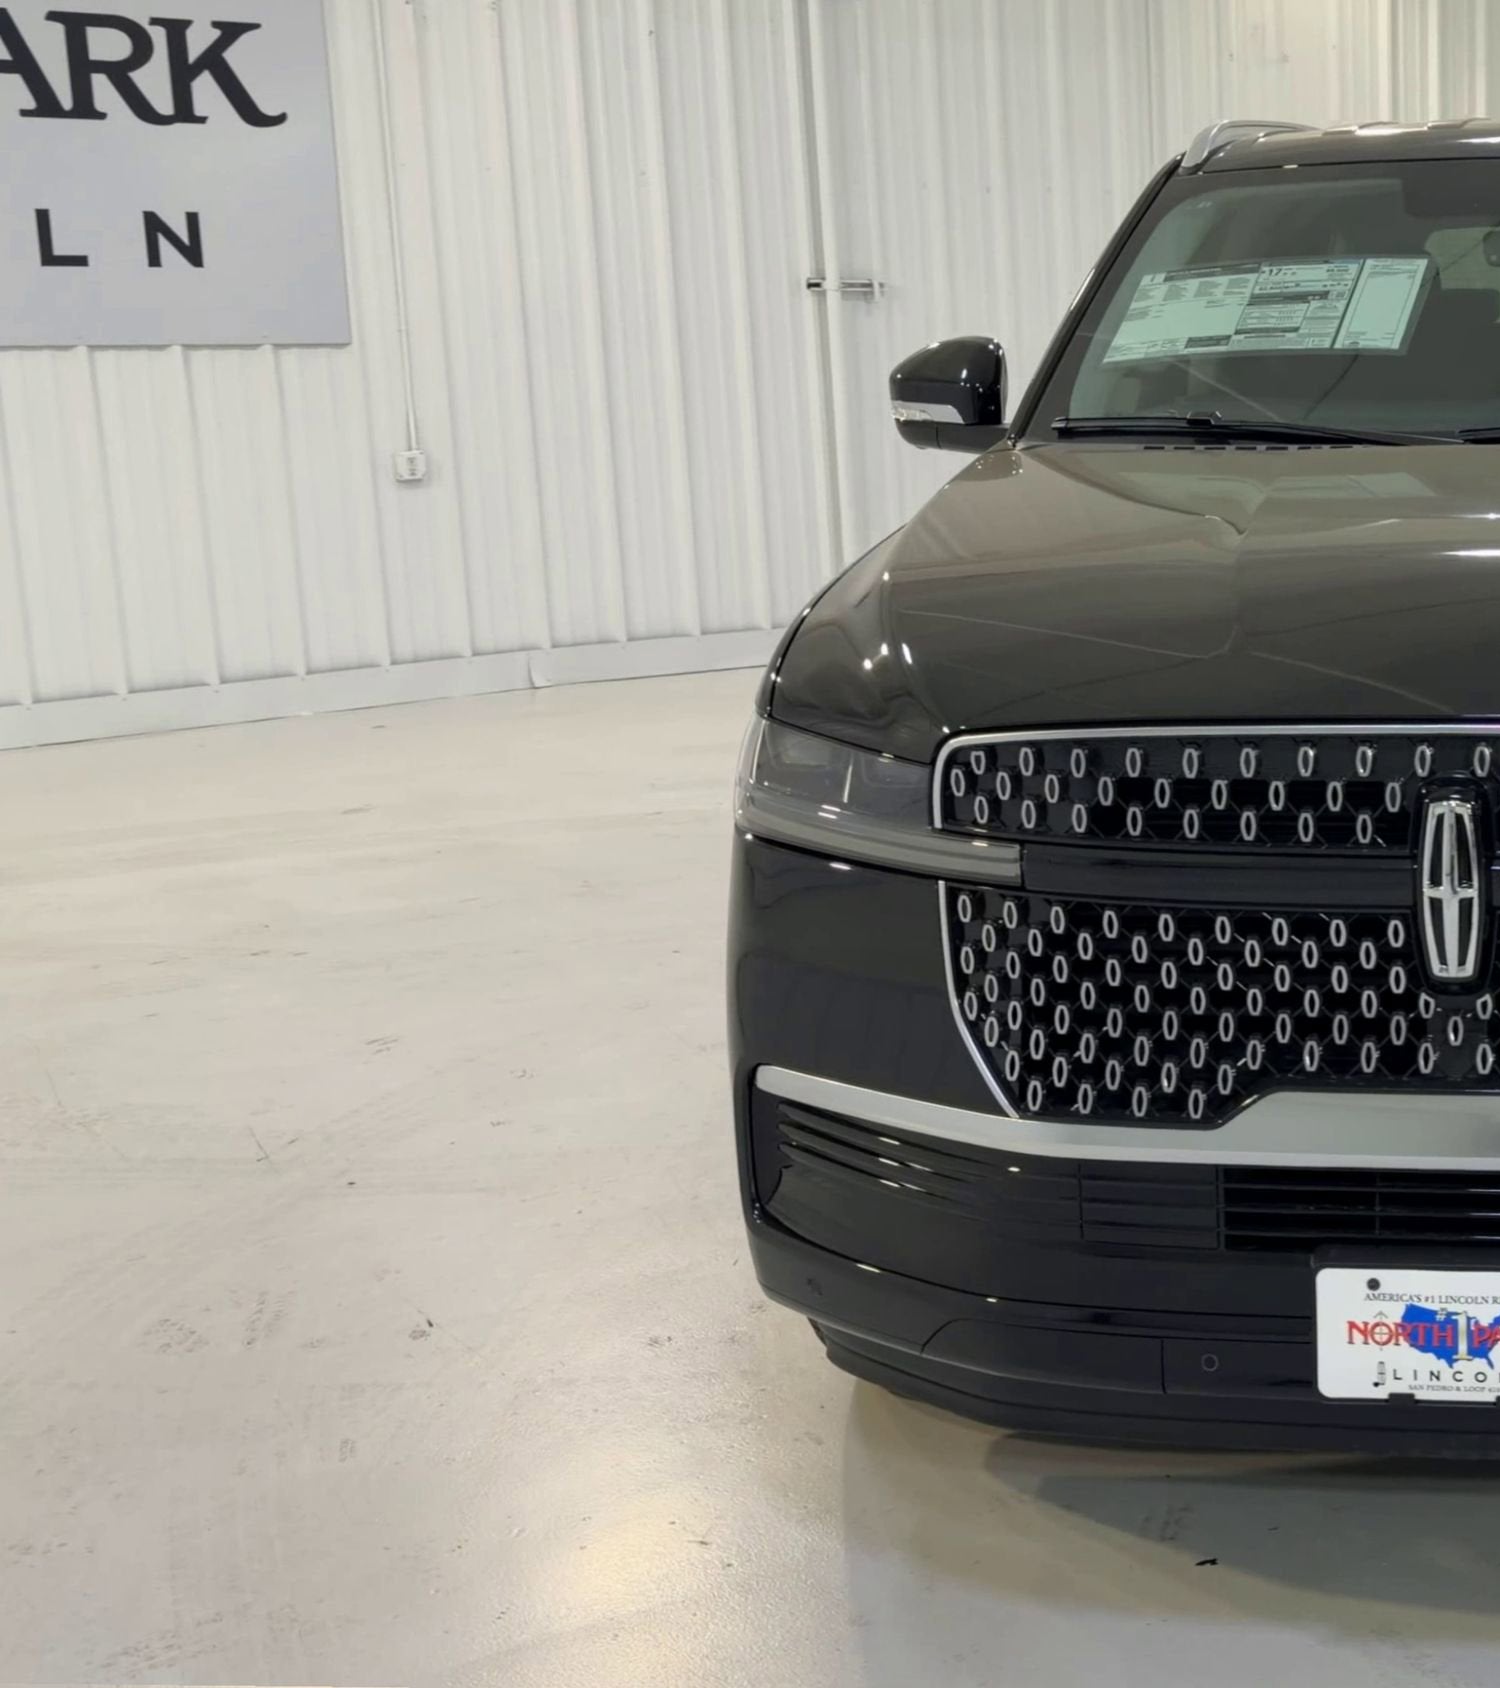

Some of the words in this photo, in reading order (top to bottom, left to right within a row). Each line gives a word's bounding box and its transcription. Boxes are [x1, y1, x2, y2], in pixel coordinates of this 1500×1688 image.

[1364, 1293, 1421, 1303] AMERICA'S
[1438, 1295, 1488, 1305] LINCOLN
[1347, 1320, 1454, 1346] NORTH
